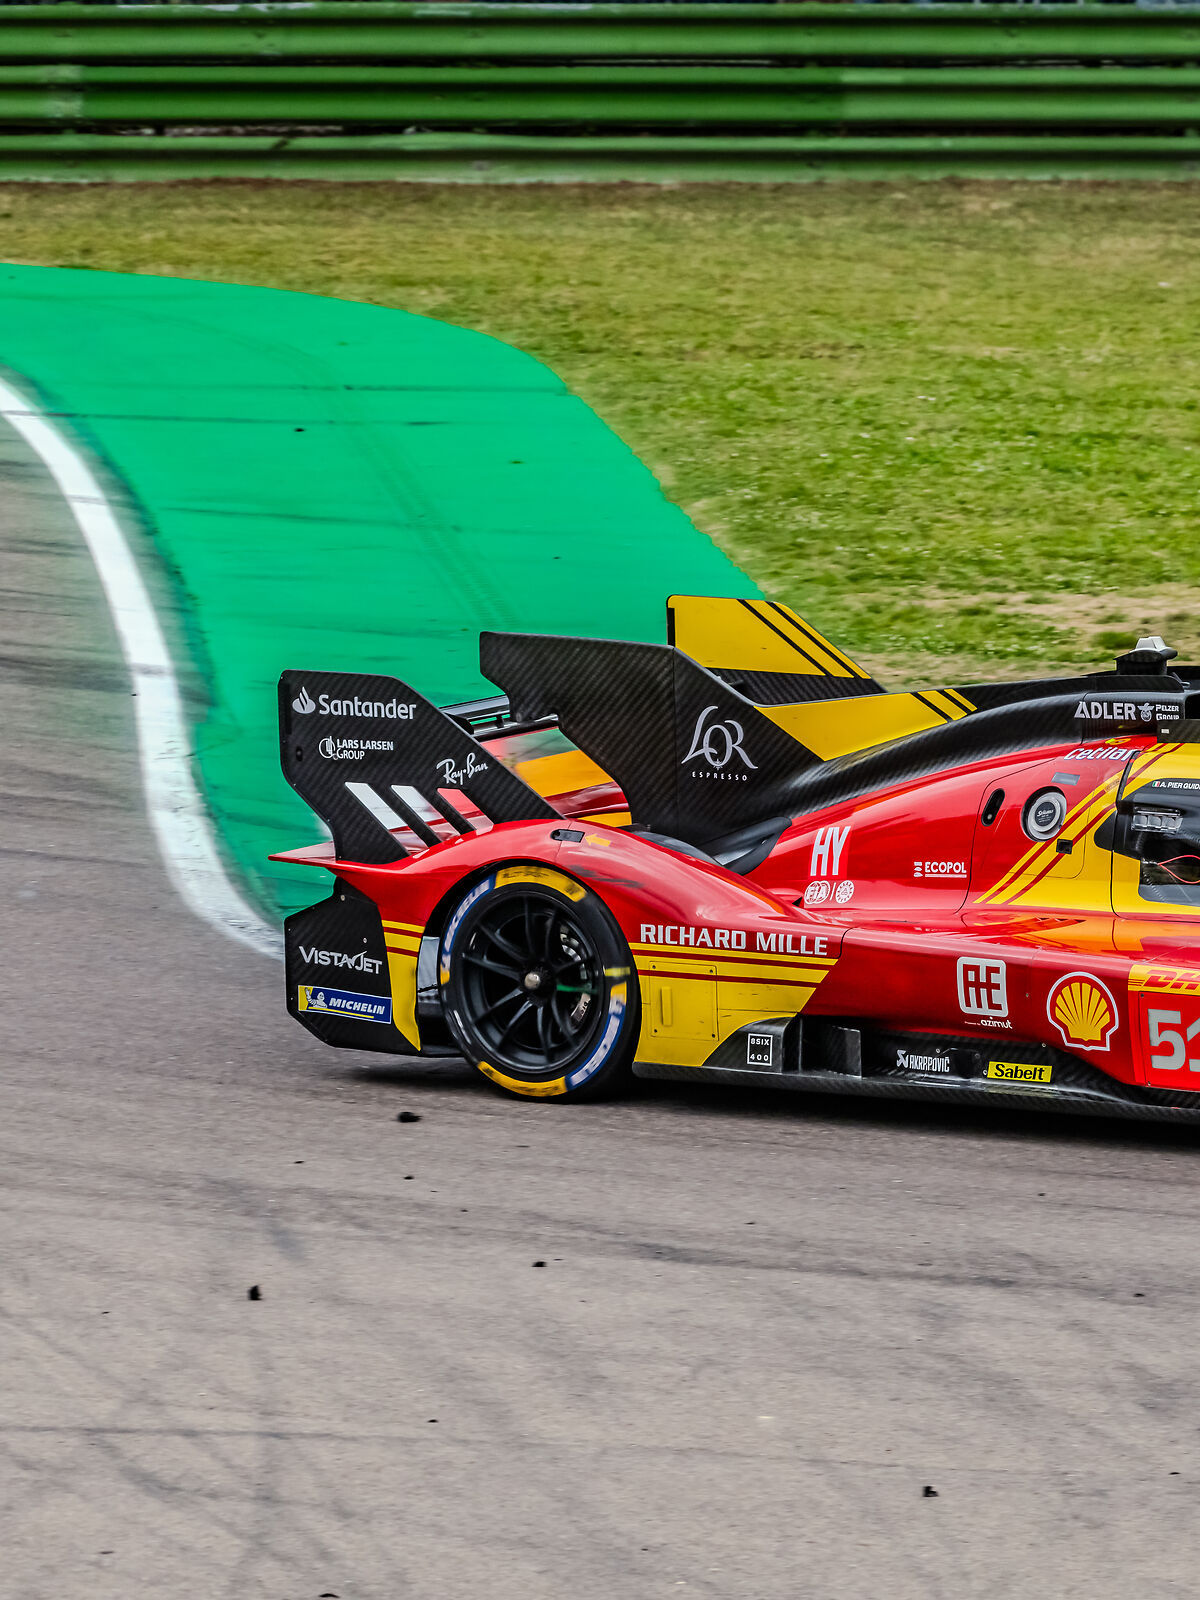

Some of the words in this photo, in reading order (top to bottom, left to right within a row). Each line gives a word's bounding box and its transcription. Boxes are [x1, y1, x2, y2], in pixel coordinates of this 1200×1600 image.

[318, 694, 417, 720] Santander
[1074, 701, 1137, 720] ADLER
[336, 738, 359, 750] LARS
[360, 739, 394, 751] LARSEN
[336, 749, 365, 760] GROUP
[692, 771, 748, 781] ESPRESSO
[1168, 781, 1183, 789] PIER
[810, 826, 851, 877] HY
[924, 861, 967, 874] ECOPOL
[640, 924, 747, 950] RICHARD
[756, 932, 829, 956] MILLE
[329, 997, 386, 1015] MICHELIN
[980, 1016, 1013, 1029] azimut
[749, 1053, 769, 1062] 400
[994, 1063, 1046, 1081] Sabelt
